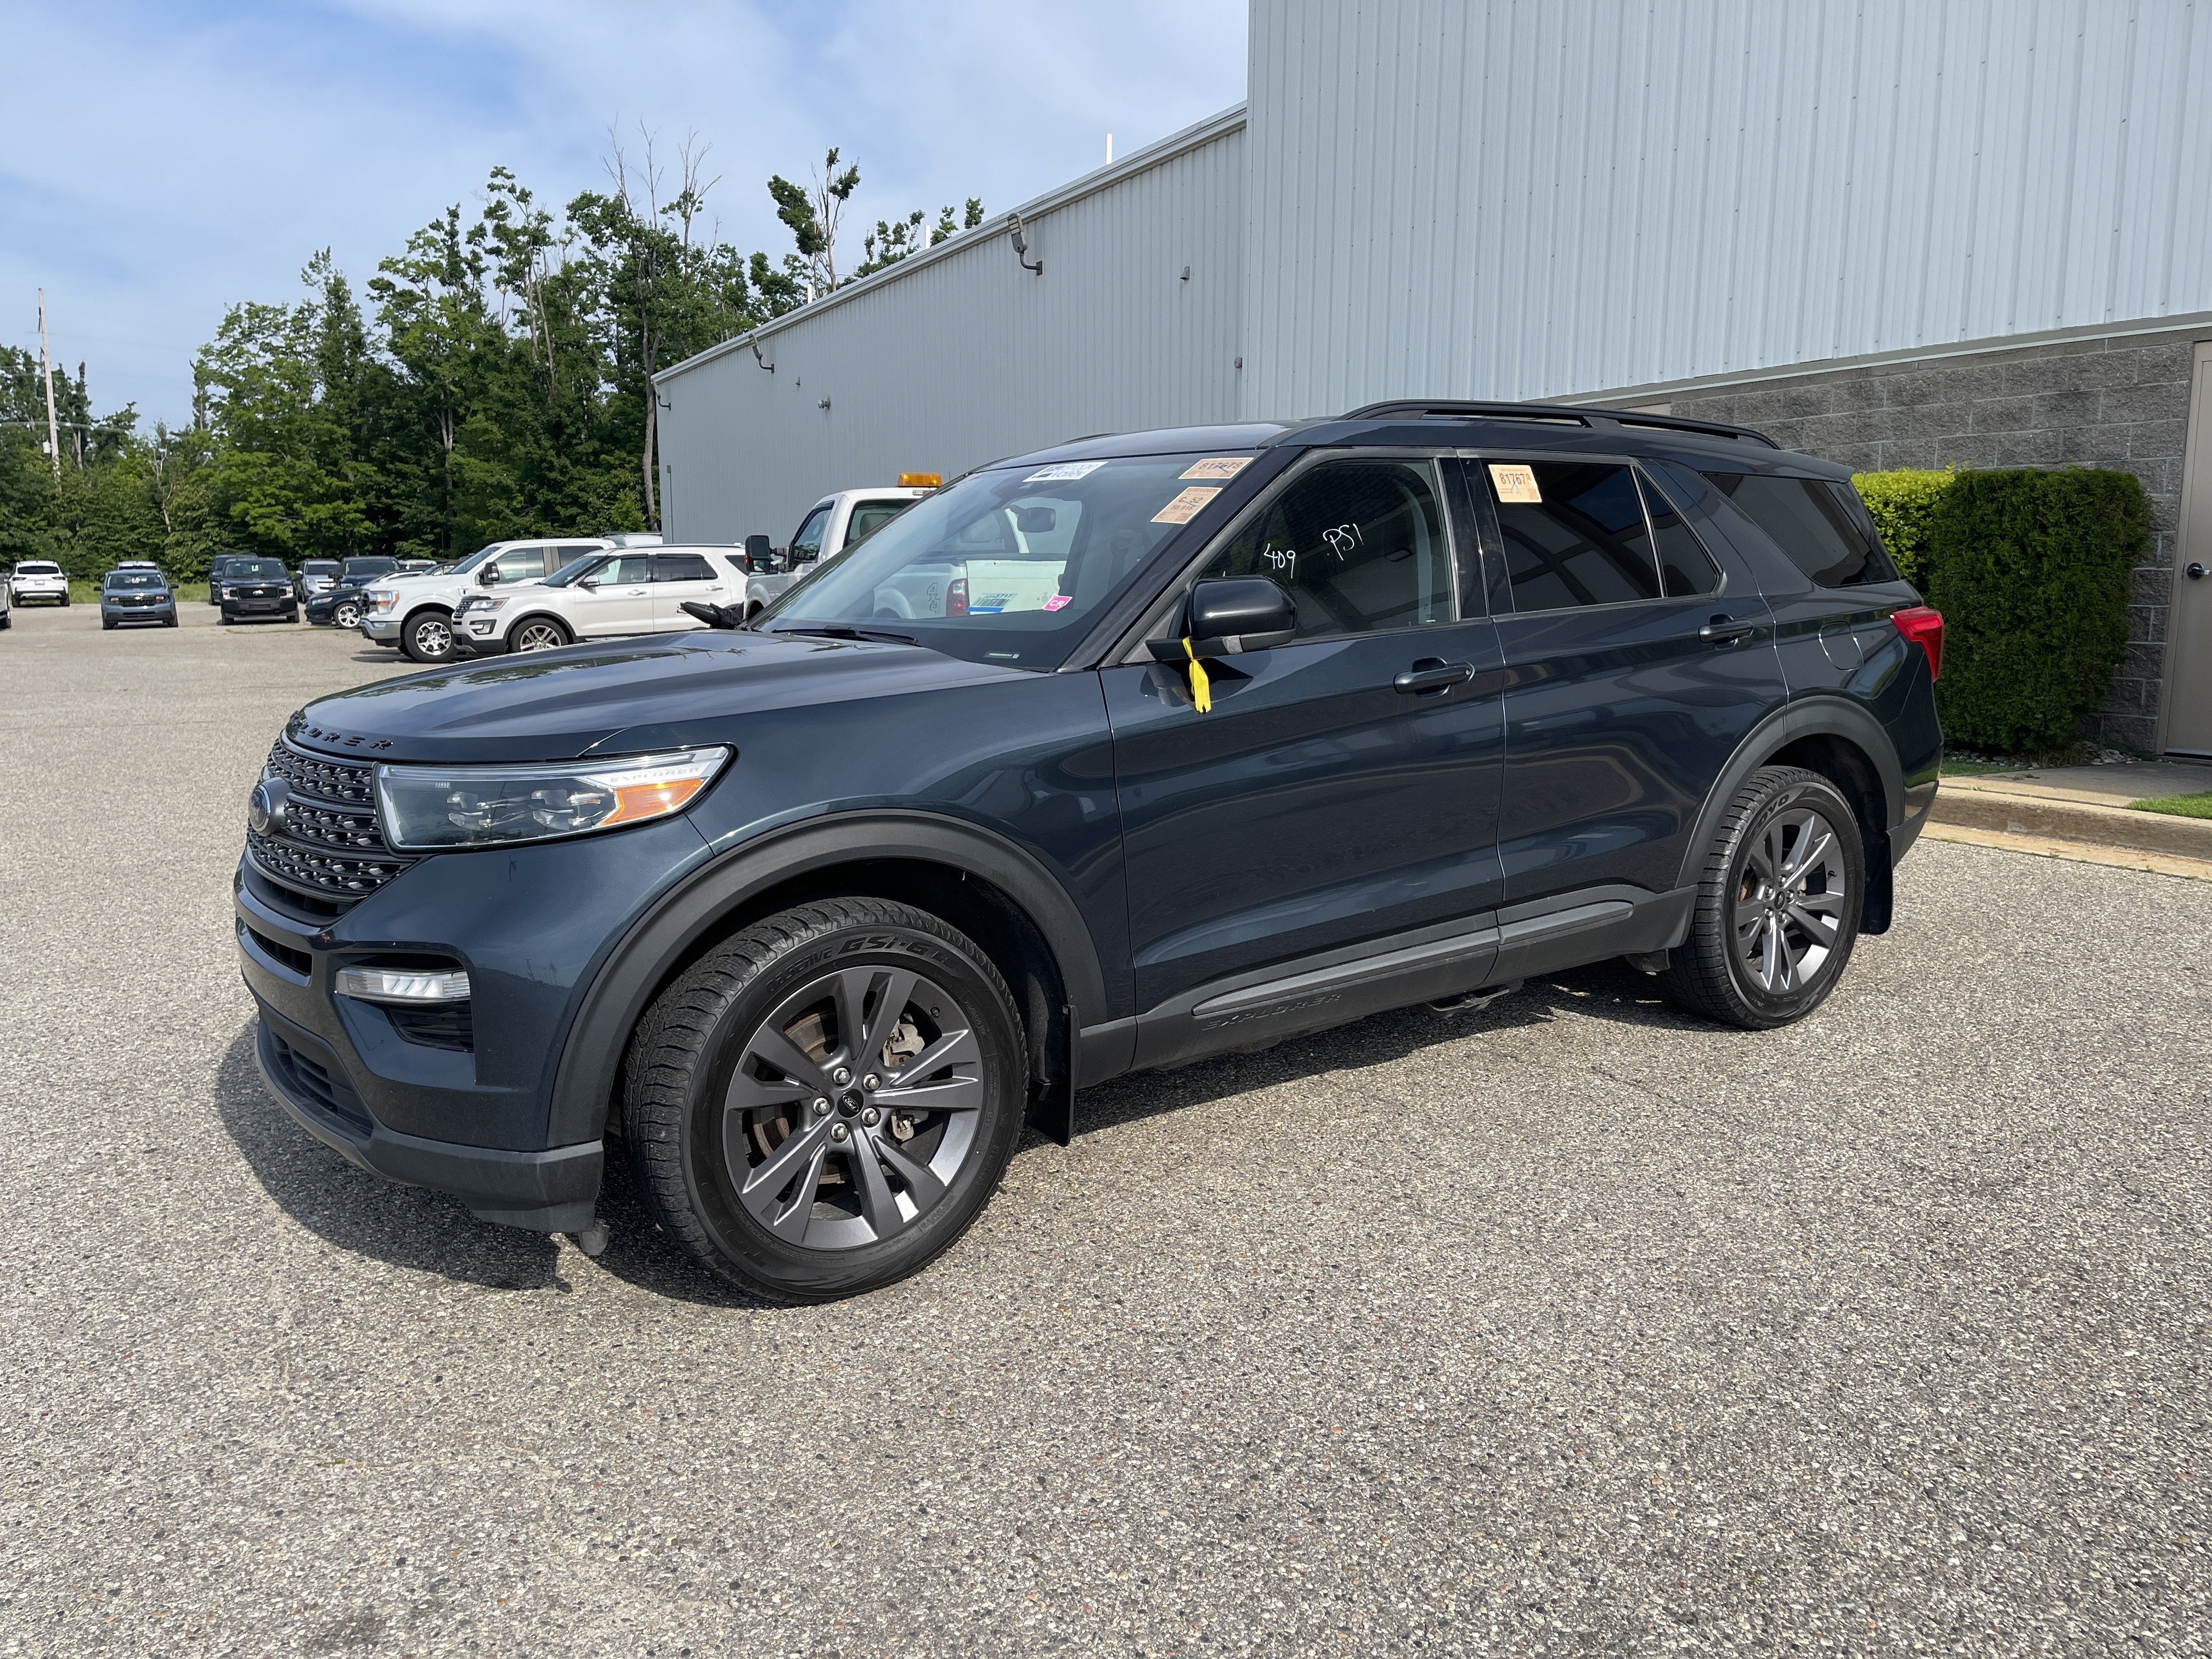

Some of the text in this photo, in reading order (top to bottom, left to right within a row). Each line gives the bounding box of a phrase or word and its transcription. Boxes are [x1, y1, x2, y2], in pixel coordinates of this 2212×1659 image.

[1499, 473, 1532, 485] 817678
[610, 768, 699, 783] EXPLORER
[1201, 994, 1342, 1031] EXPLORER
